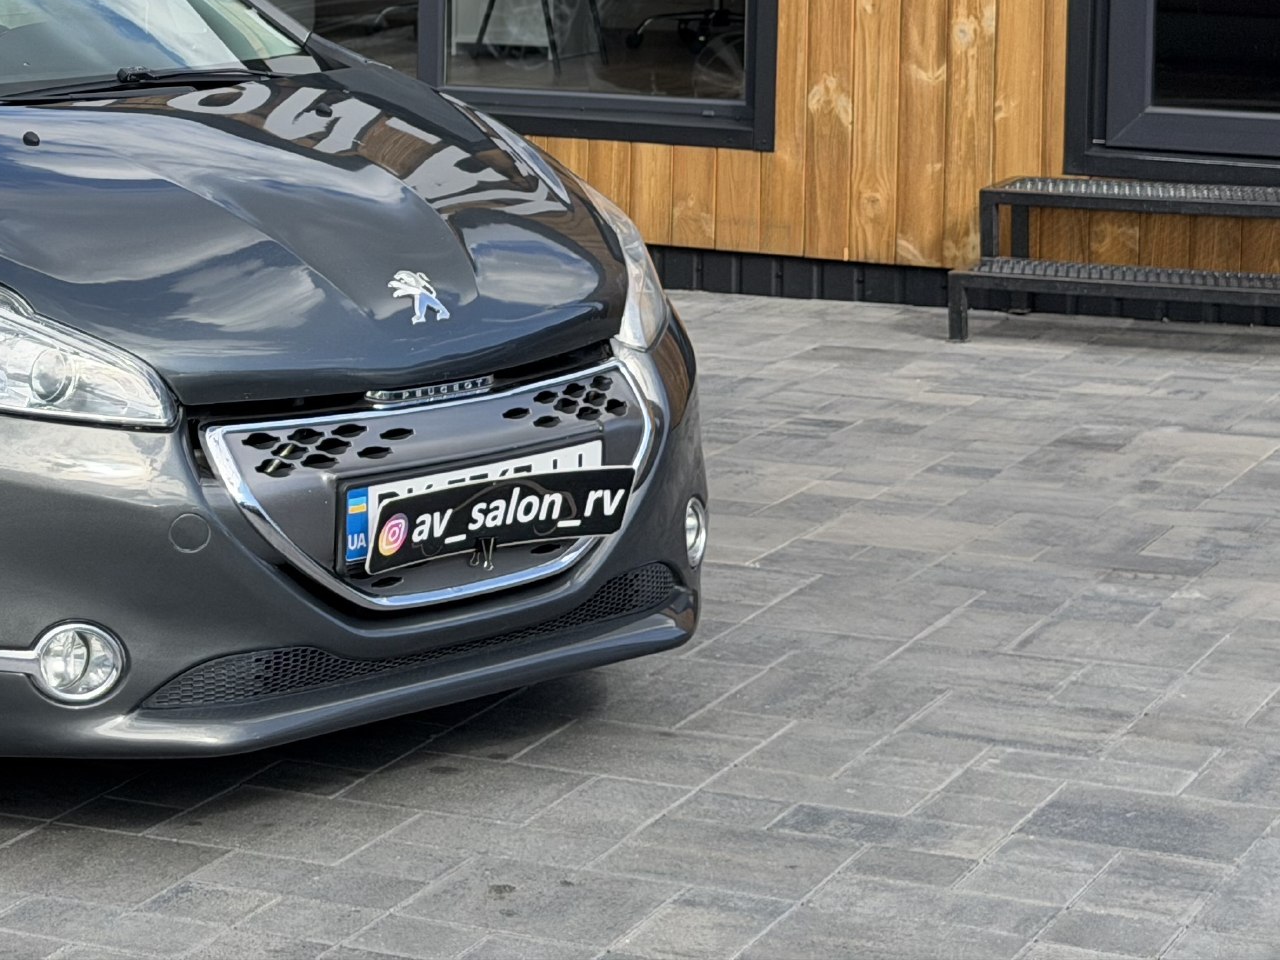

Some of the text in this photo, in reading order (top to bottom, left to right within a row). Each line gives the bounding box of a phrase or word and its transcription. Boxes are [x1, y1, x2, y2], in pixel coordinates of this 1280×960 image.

[402, 379, 482, 399] PEUGEOT
[411, 487, 625, 544] av_salon_rv
[347, 532, 367, 550] UA
